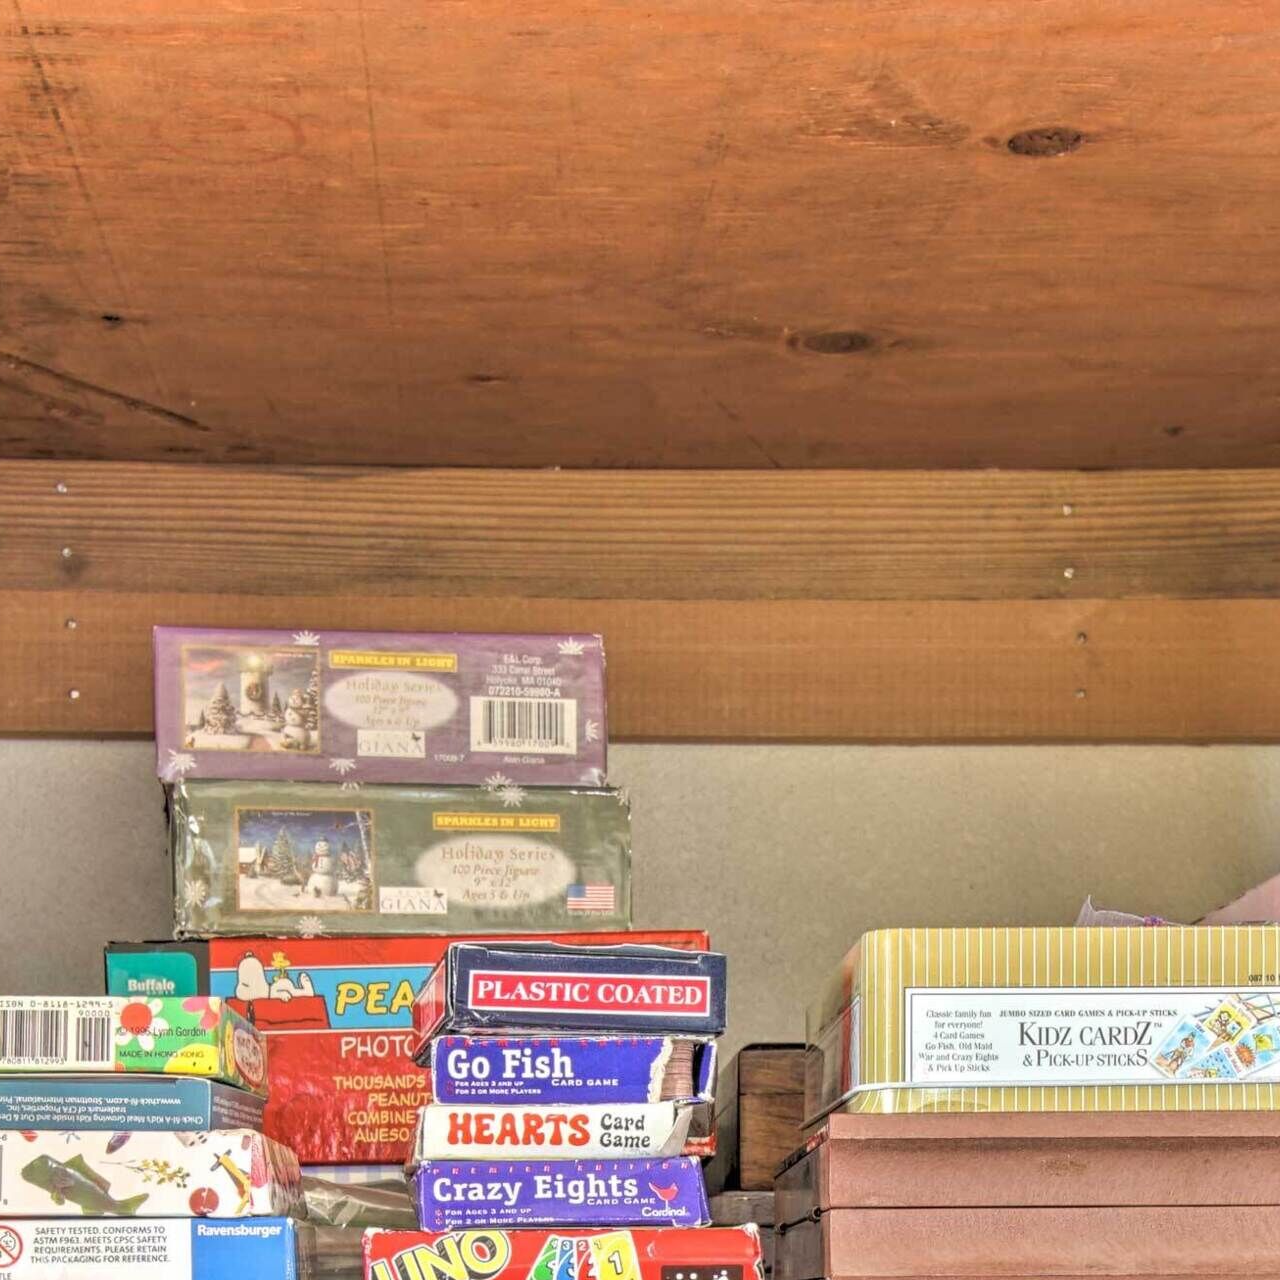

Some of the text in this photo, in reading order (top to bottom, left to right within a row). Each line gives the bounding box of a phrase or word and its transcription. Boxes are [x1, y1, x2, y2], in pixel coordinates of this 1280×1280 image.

[437, 817, 556, 827] SPARKLES IN LIGHT
[128, 979, 175, 991] Buffalo
[476, 980, 702, 1006] PLASTIC COATED
[154, 1027, 206, 1038] Lynn Gordon
[1019, 1022, 1072, 1046] KIDZ
[447, 1049, 573, 1080] Go Fish
[1022, 1050, 1148, 1066] & PICK-UP STICKS
[447, 1112, 646, 1146] HEARTS Card
[599, 1131, 651, 1149] Game
[433, 1178, 639, 1208] Crazy Eights
[103, 1226, 152, 1234] CONFORMS
[197, 1224, 282, 1238] Ravensburger
